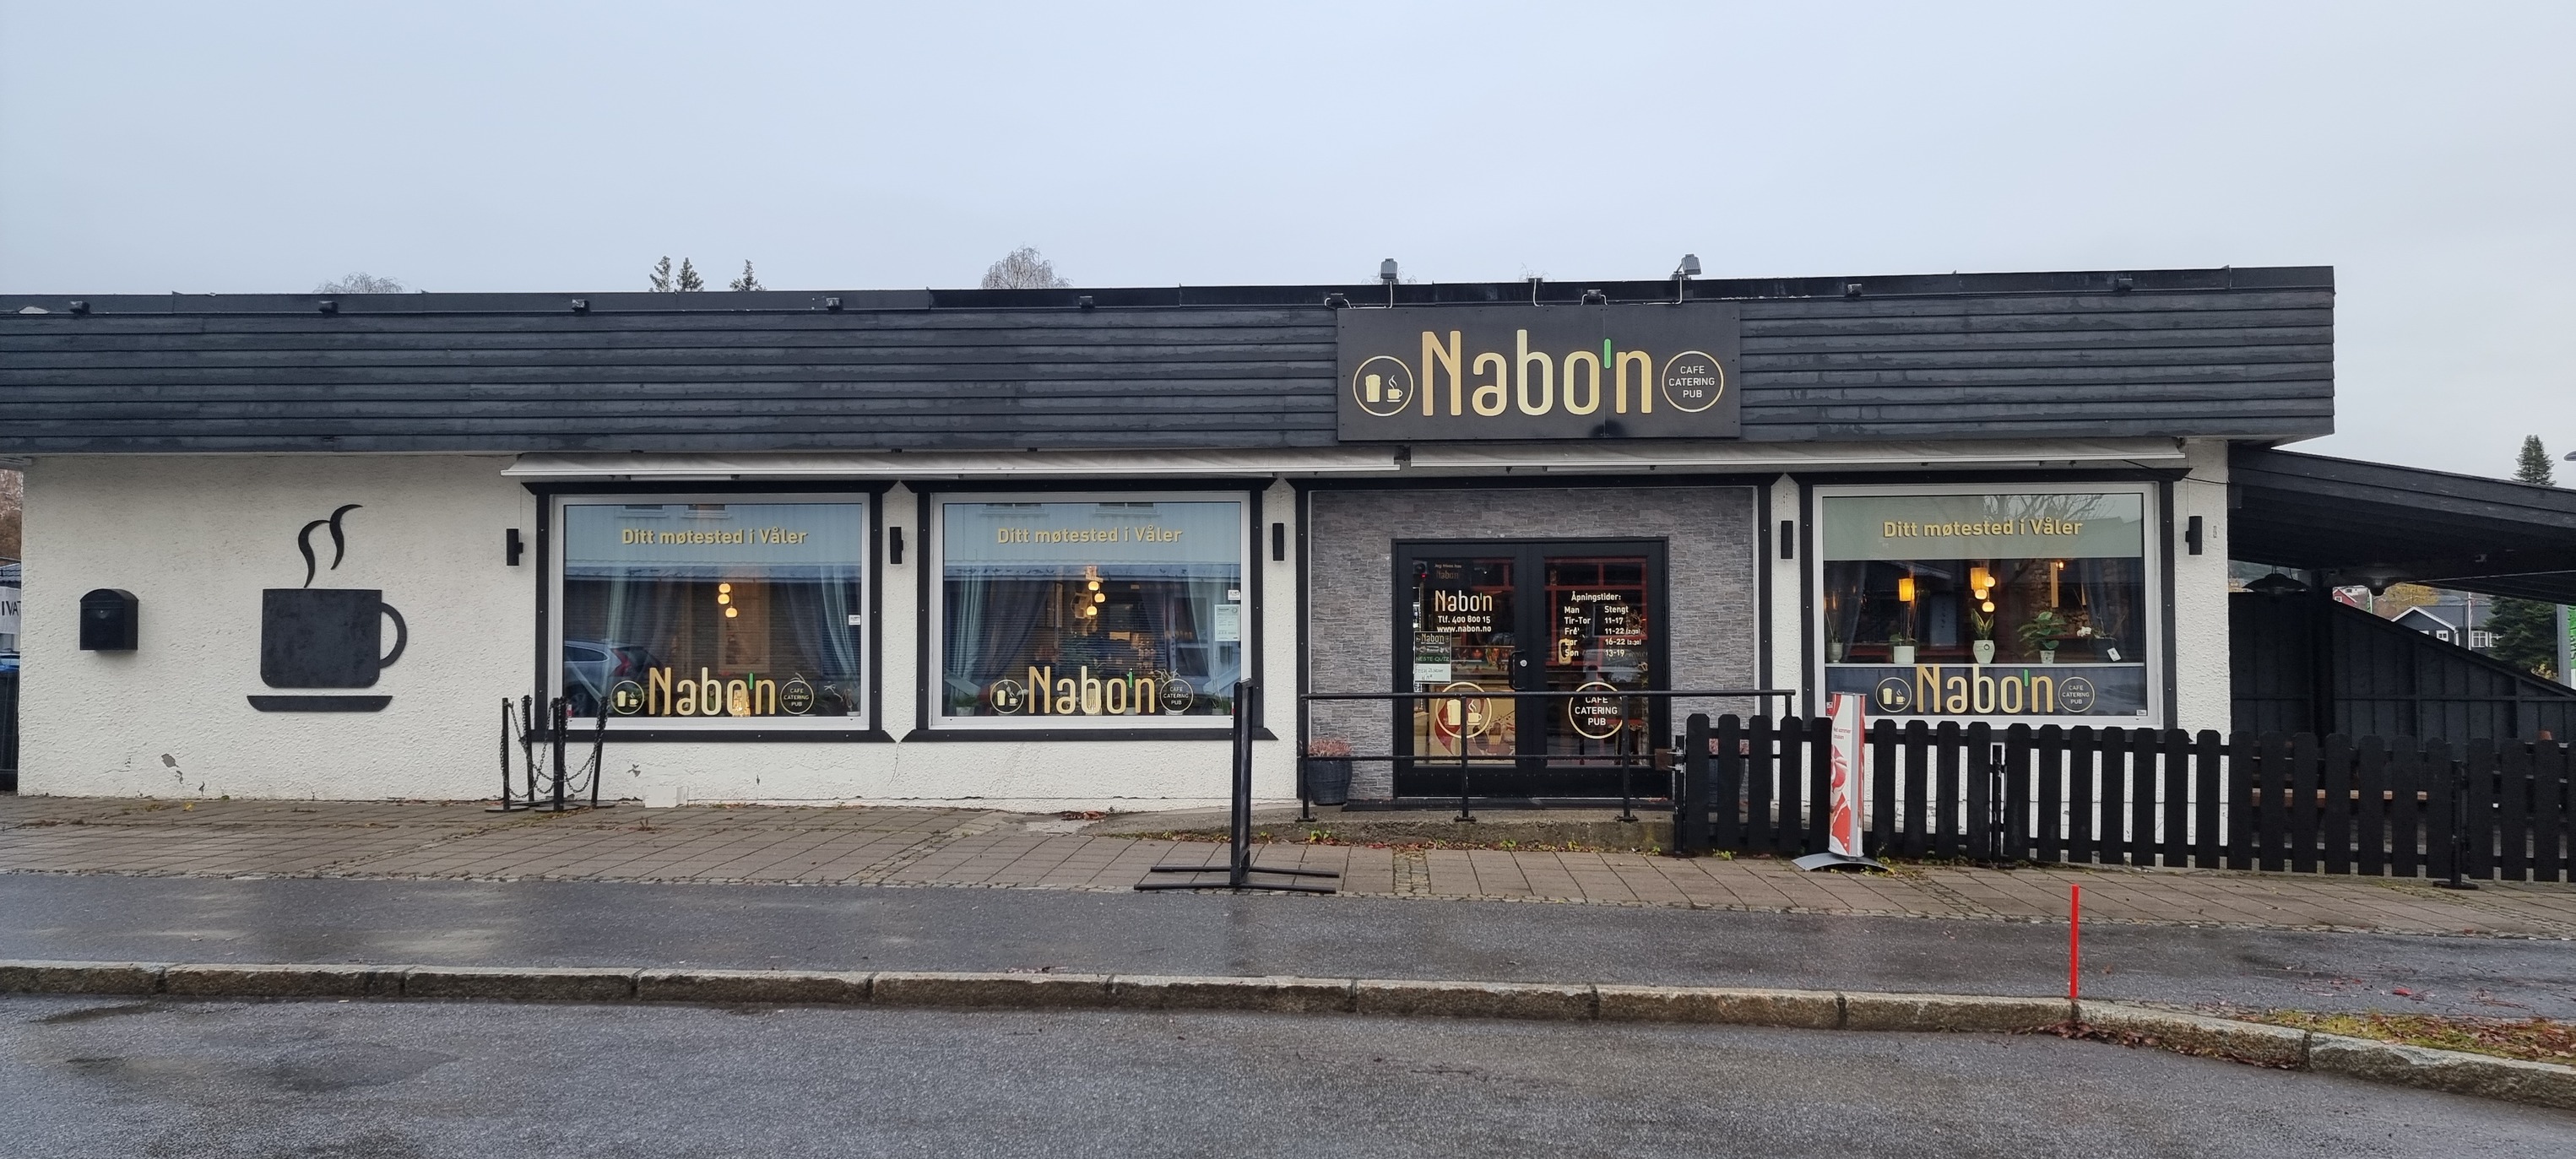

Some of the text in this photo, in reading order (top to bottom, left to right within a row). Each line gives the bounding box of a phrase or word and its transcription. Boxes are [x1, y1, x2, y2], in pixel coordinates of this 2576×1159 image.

[1422, 329, 1652, 416] Nabo'n
[1680, 366, 1705, 374] CAFE
[1668, 377, 1715, 387] CATERING
[1683, 389, 1702, 398] PUB
[1883, 517, 2084, 538] Ditt møtested i Våler
[621, 526, 808, 544] Ditt møtested i Våler
[998, 524, 1183, 544] Ditt møtested i Våler
[1434, 589, 1493, 612] Nabo'n
[1570, 590, 1622, 603] Åpningstider:
[1604, 605, 1629, 615] Stengt
[1451, 615, 1466, 624] 400
[1467, 615, 1481, 623] 800
[1482, 615, 1491, 624] 15
[1564, 616, 1592, 625] Tir-Tor
[1565, 648, 1579, 657] Søn
[648, 667, 776, 716] Nabo'n
[1028, 665, 1155, 715] Nabo'n
[1916, 663, 2054, 713] Nabo'n
[1575, 707, 1618, 715] CATERING
[1587, 718, 1607, 726] PUB
